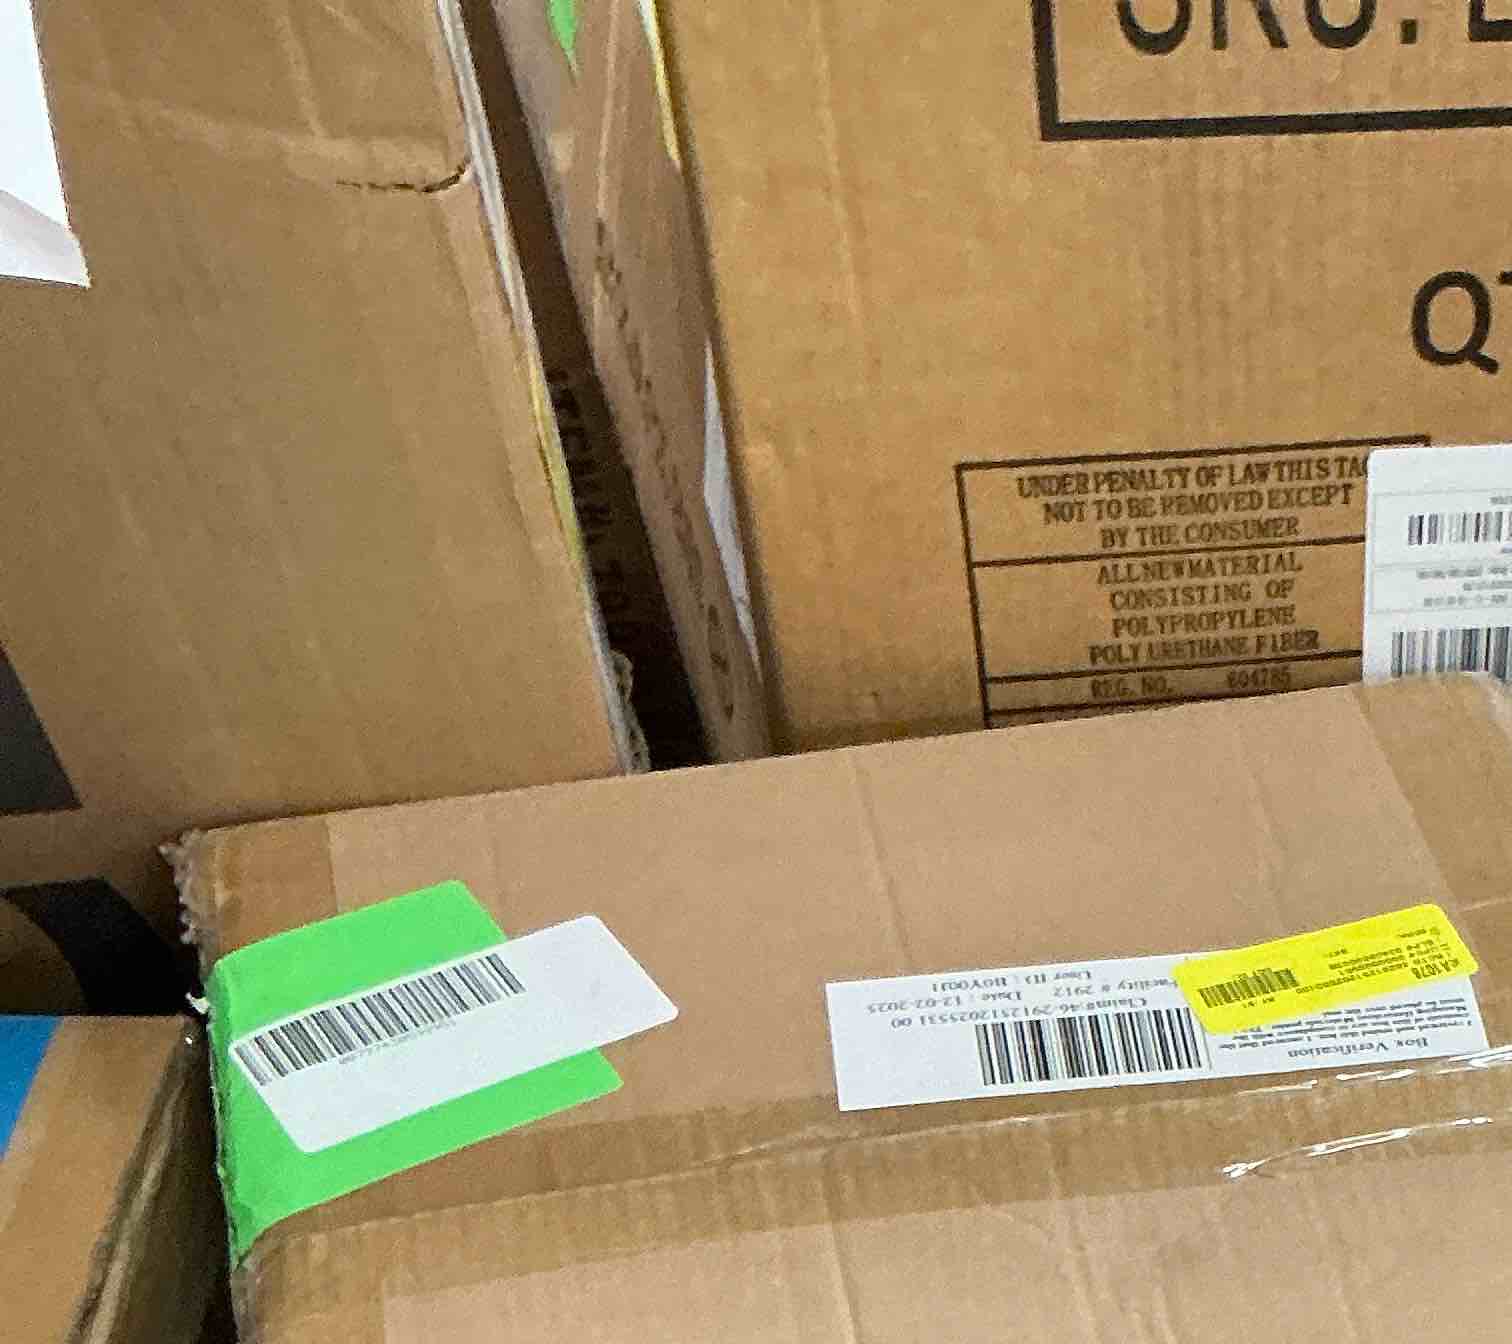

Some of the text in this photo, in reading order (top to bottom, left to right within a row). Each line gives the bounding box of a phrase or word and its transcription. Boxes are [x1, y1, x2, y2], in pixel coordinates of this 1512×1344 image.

[1016, 470, 1089, 499] UNDER
[1094, 465, 1191, 494] PENALTY
[1195, 464, 1224, 488] OF
[1228, 461, 1272, 486] LAW
[1273, 457, 1330, 483] THIS
[1042, 482, 1353, 526] NOT TO BE REMOVED EXCEPT
[1101, 516, 1299, 550] BY THE CONSUMER
[1110, 578, 1295, 612] CONSISTING OF
[1112, 604, 1296, 639] POLYPROPYLENE
[1287, 1039, 1389, 1060] Verification
